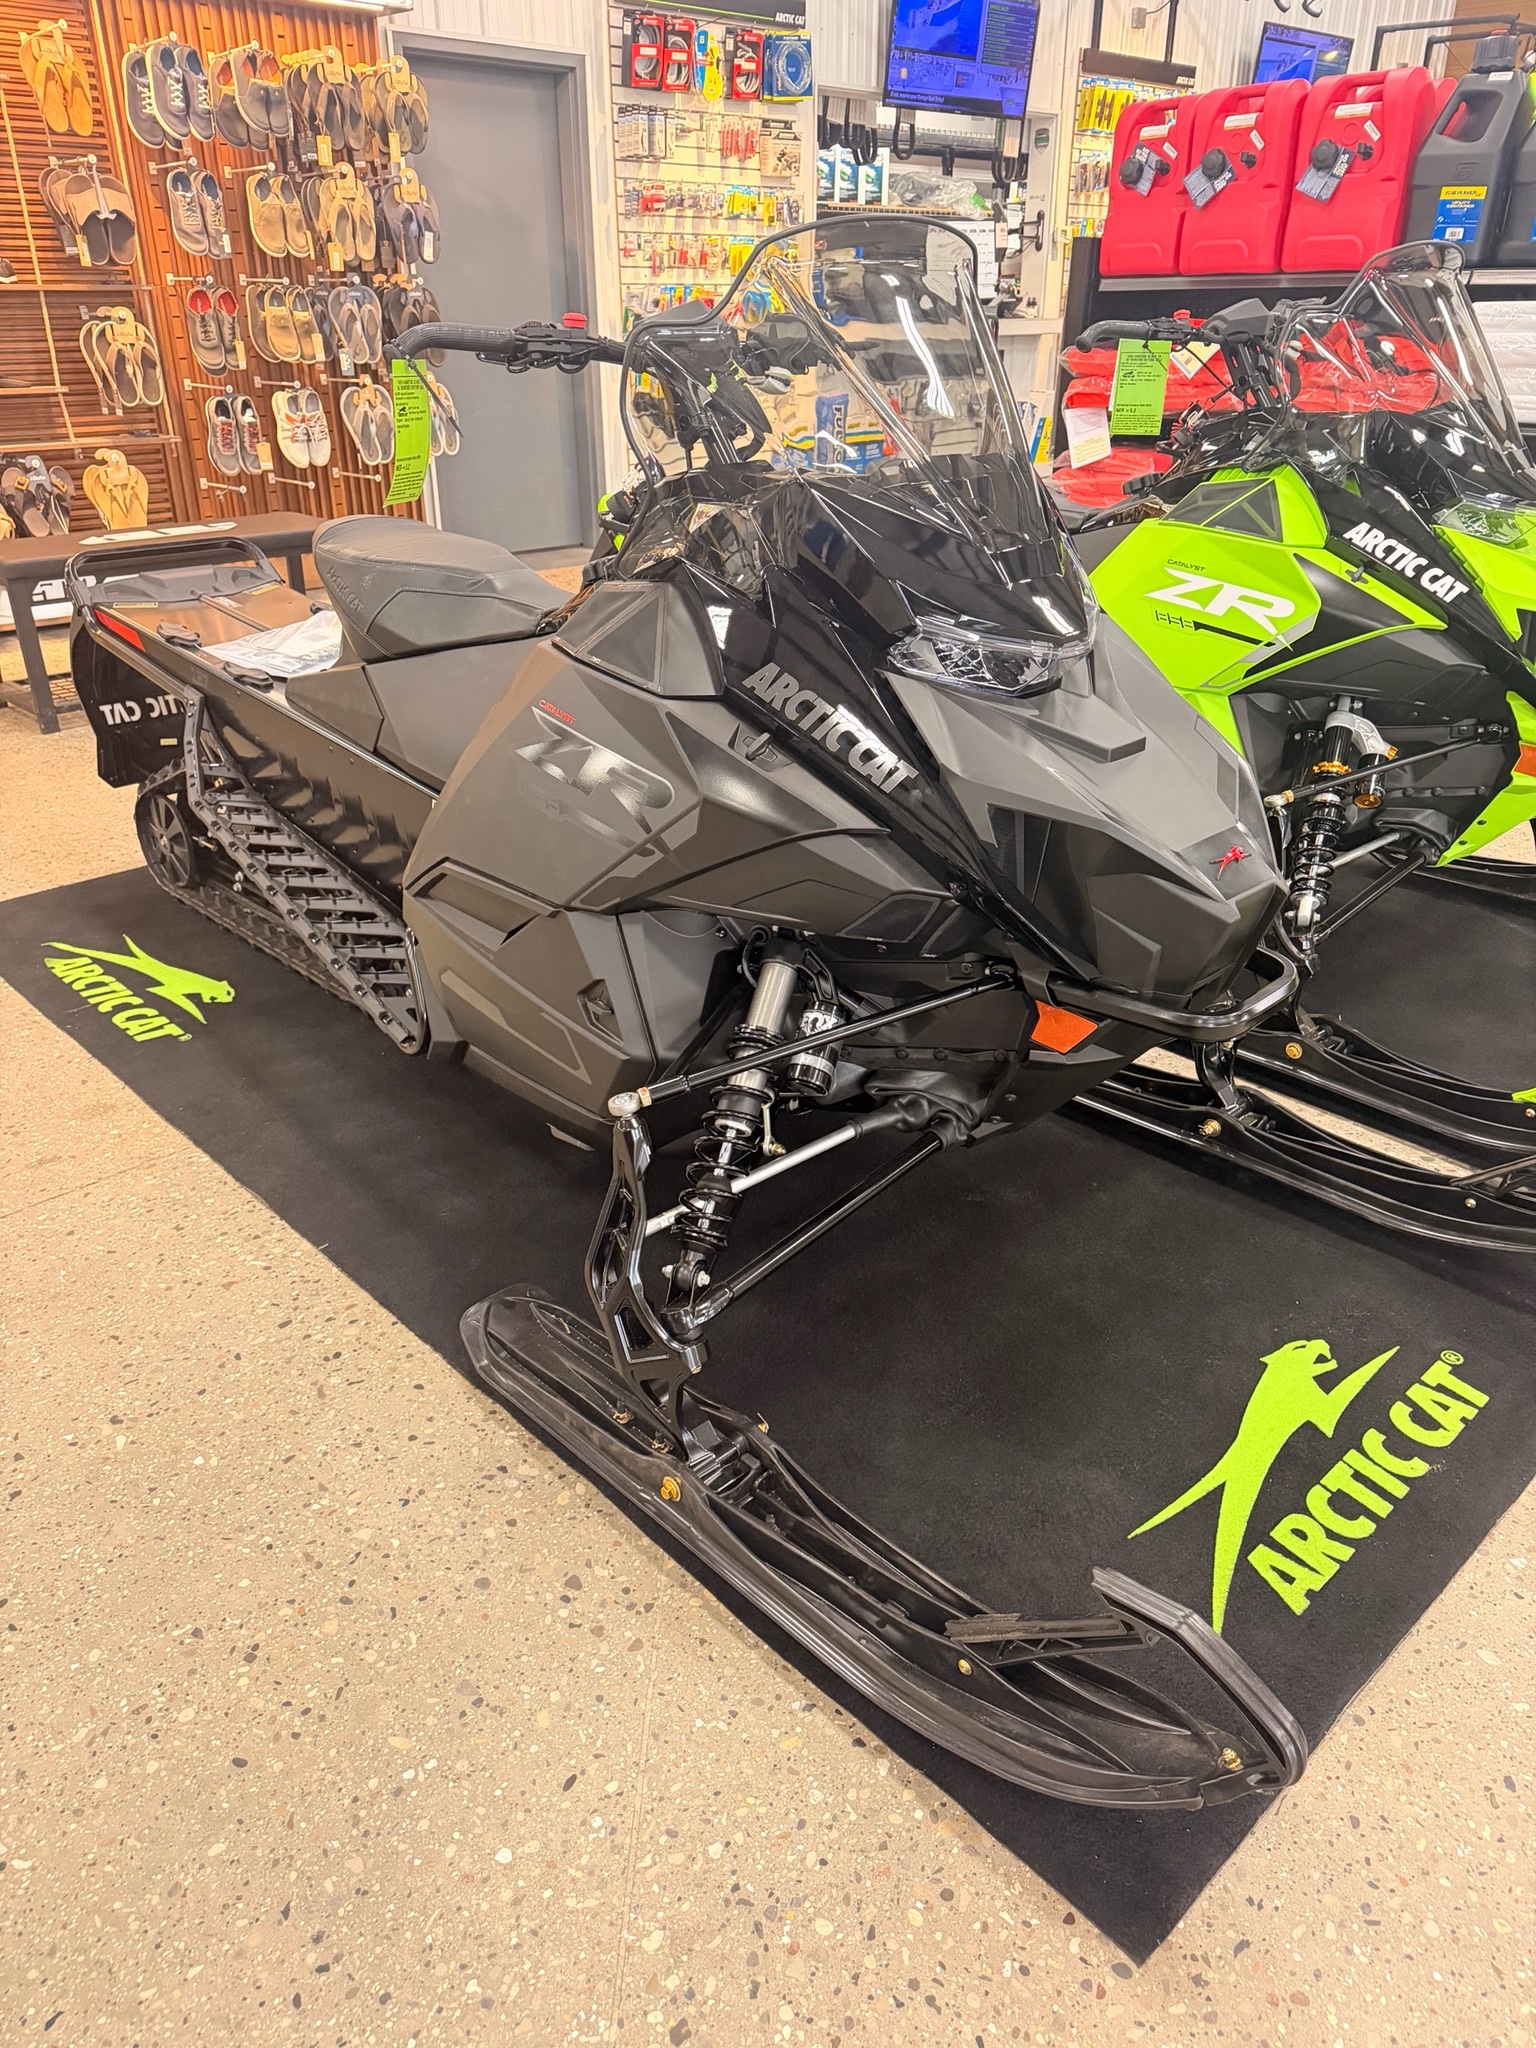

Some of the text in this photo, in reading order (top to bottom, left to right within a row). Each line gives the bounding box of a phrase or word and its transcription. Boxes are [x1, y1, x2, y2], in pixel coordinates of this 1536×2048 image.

[775, 12, 805, 25] ARCTIC CAT
[1166, 558, 1206, 572] CATALYST
[1342, 521, 1470, 603] ARCTIC CAT
[1143, 566, 1296, 652] ZR
[538, 699, 576, 725] CATALYST
[742, 661, 920, 794] ARCTIC CAT
[43, 956, 145, 1014] ARCTIC
[1247, 1428, 1430, 1616] ARCTIC
